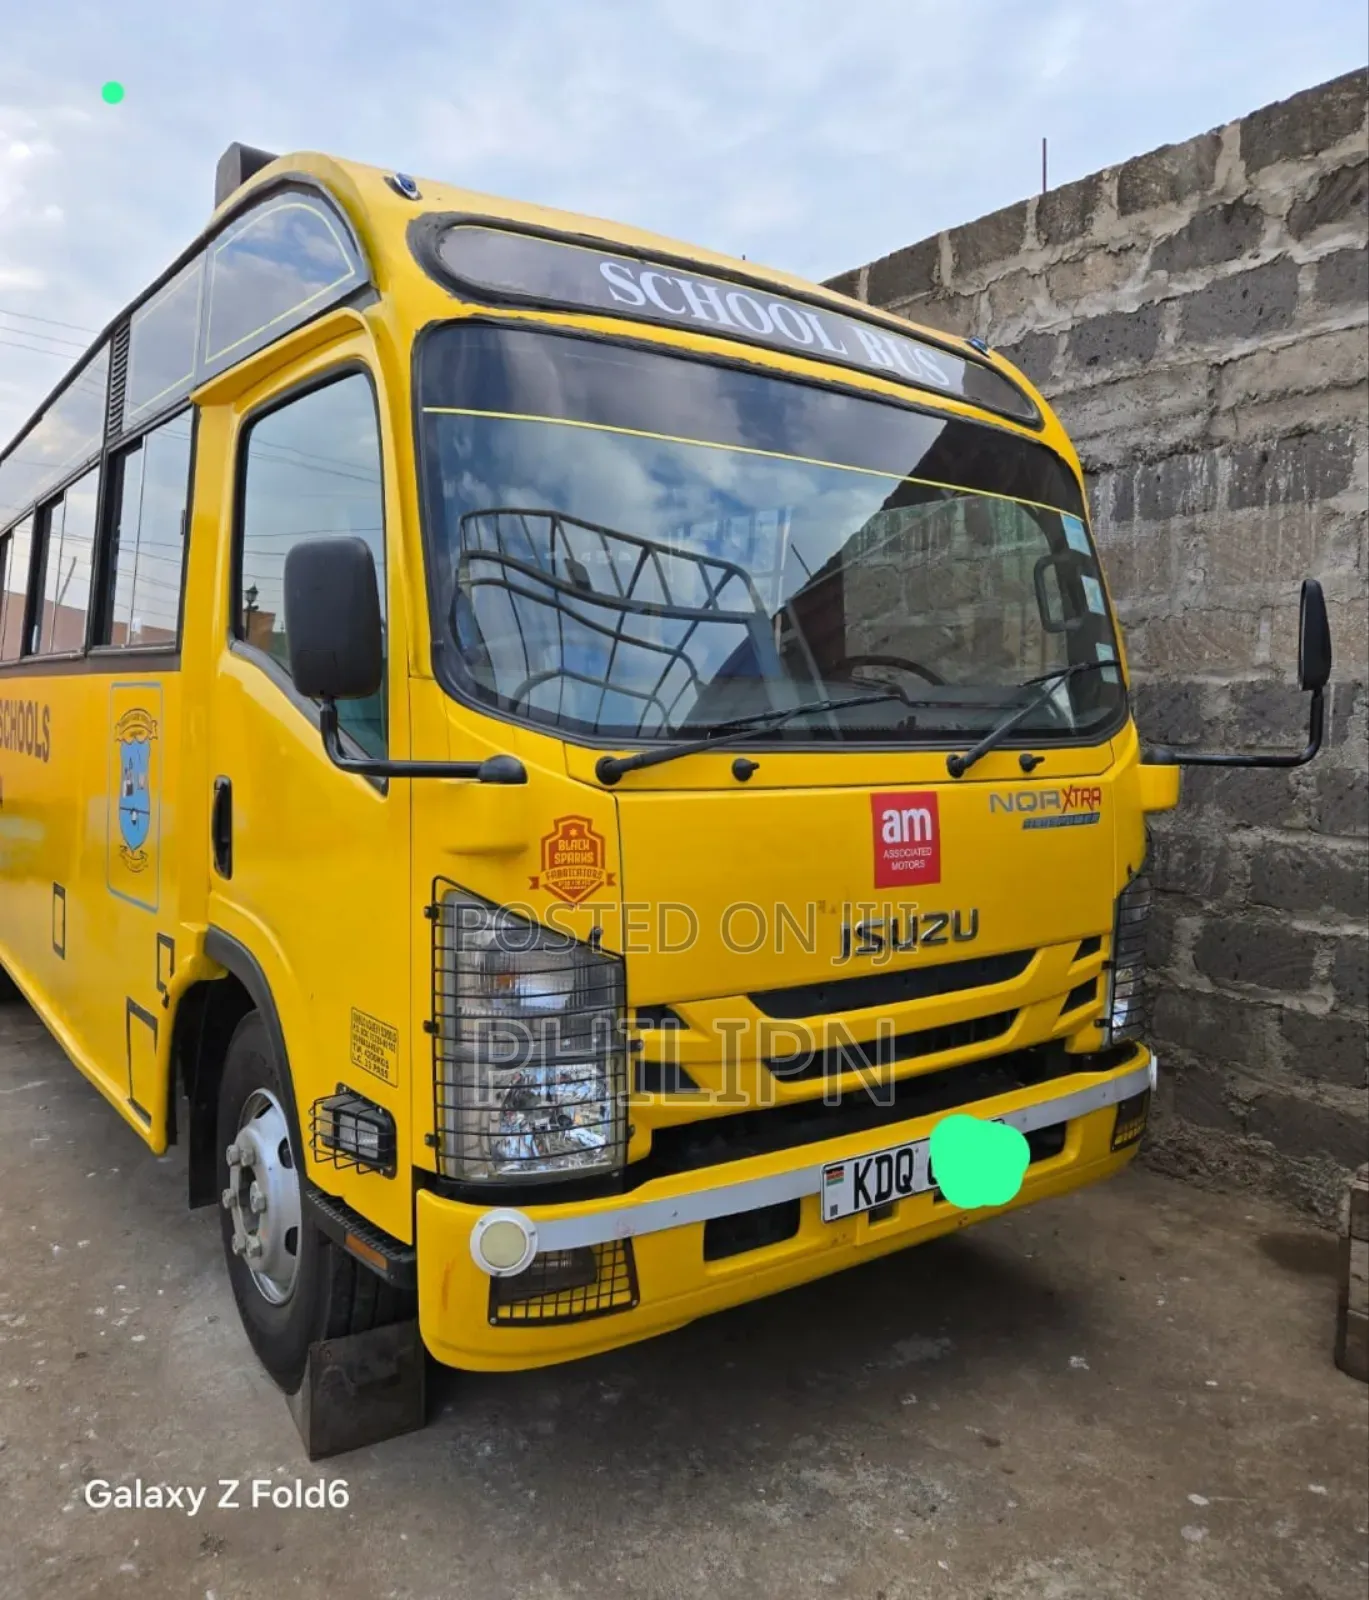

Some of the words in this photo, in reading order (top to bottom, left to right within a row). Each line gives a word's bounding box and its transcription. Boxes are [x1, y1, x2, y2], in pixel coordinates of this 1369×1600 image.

[600, 262, 847, 354] SCHOOL
[851, 326, 950, 387] BUS
[0, 699, 50, 763] CHOOLS
[1062, 785, 1102, 813] XTRA
[881, 808, 932, 844] am
[554, 852, 594, 864] SPARKS
[558, 840, 590, 851] BLACK
[883, 847, 932, 859] ASSOCIATED
[891, 860, 926, 871] MOTORS
[840, 908, 979, 958] ISUZU
[853, 1148, 913, 1210] KDQ
